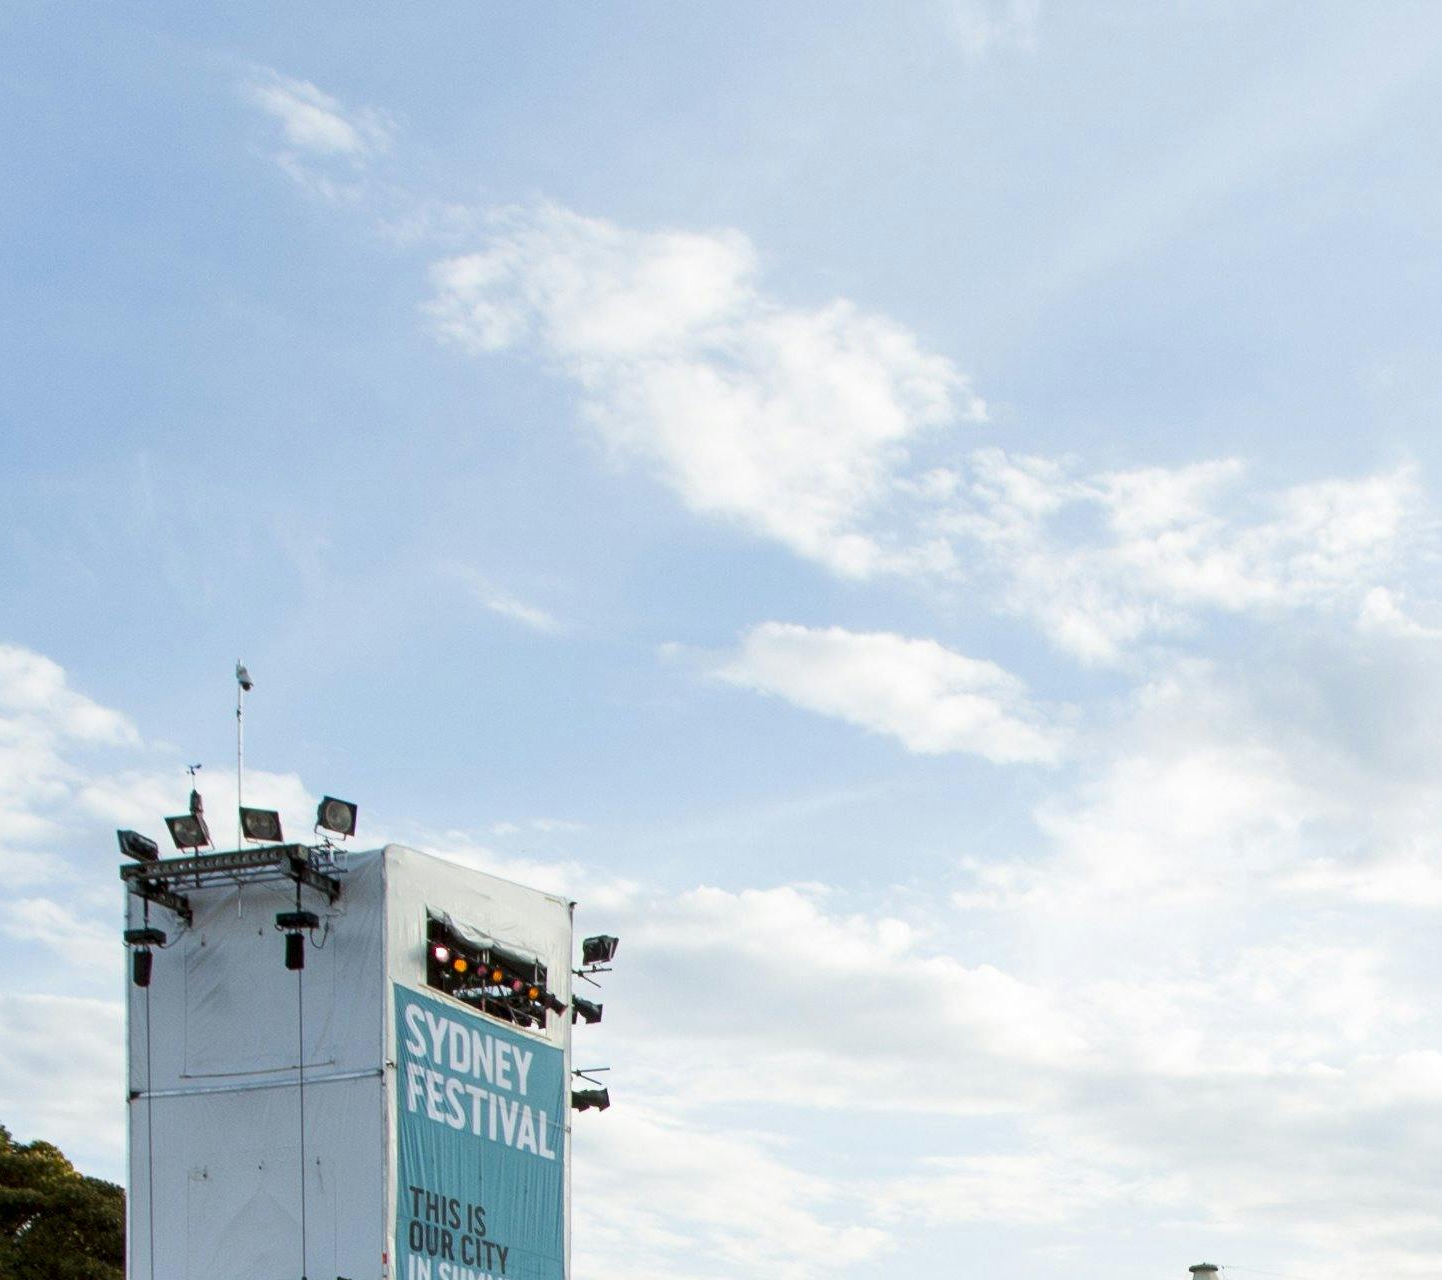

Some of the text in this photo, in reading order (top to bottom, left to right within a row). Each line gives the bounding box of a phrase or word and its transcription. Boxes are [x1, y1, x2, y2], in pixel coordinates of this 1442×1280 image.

[405, 1003, 533, 1096] SYDNEY
[408, 1061, 555, 1160] FESTIVAL
[410, 1186, 487, 1237] THIS IS
[410, 1220, 509, 1274] OUR CITY
